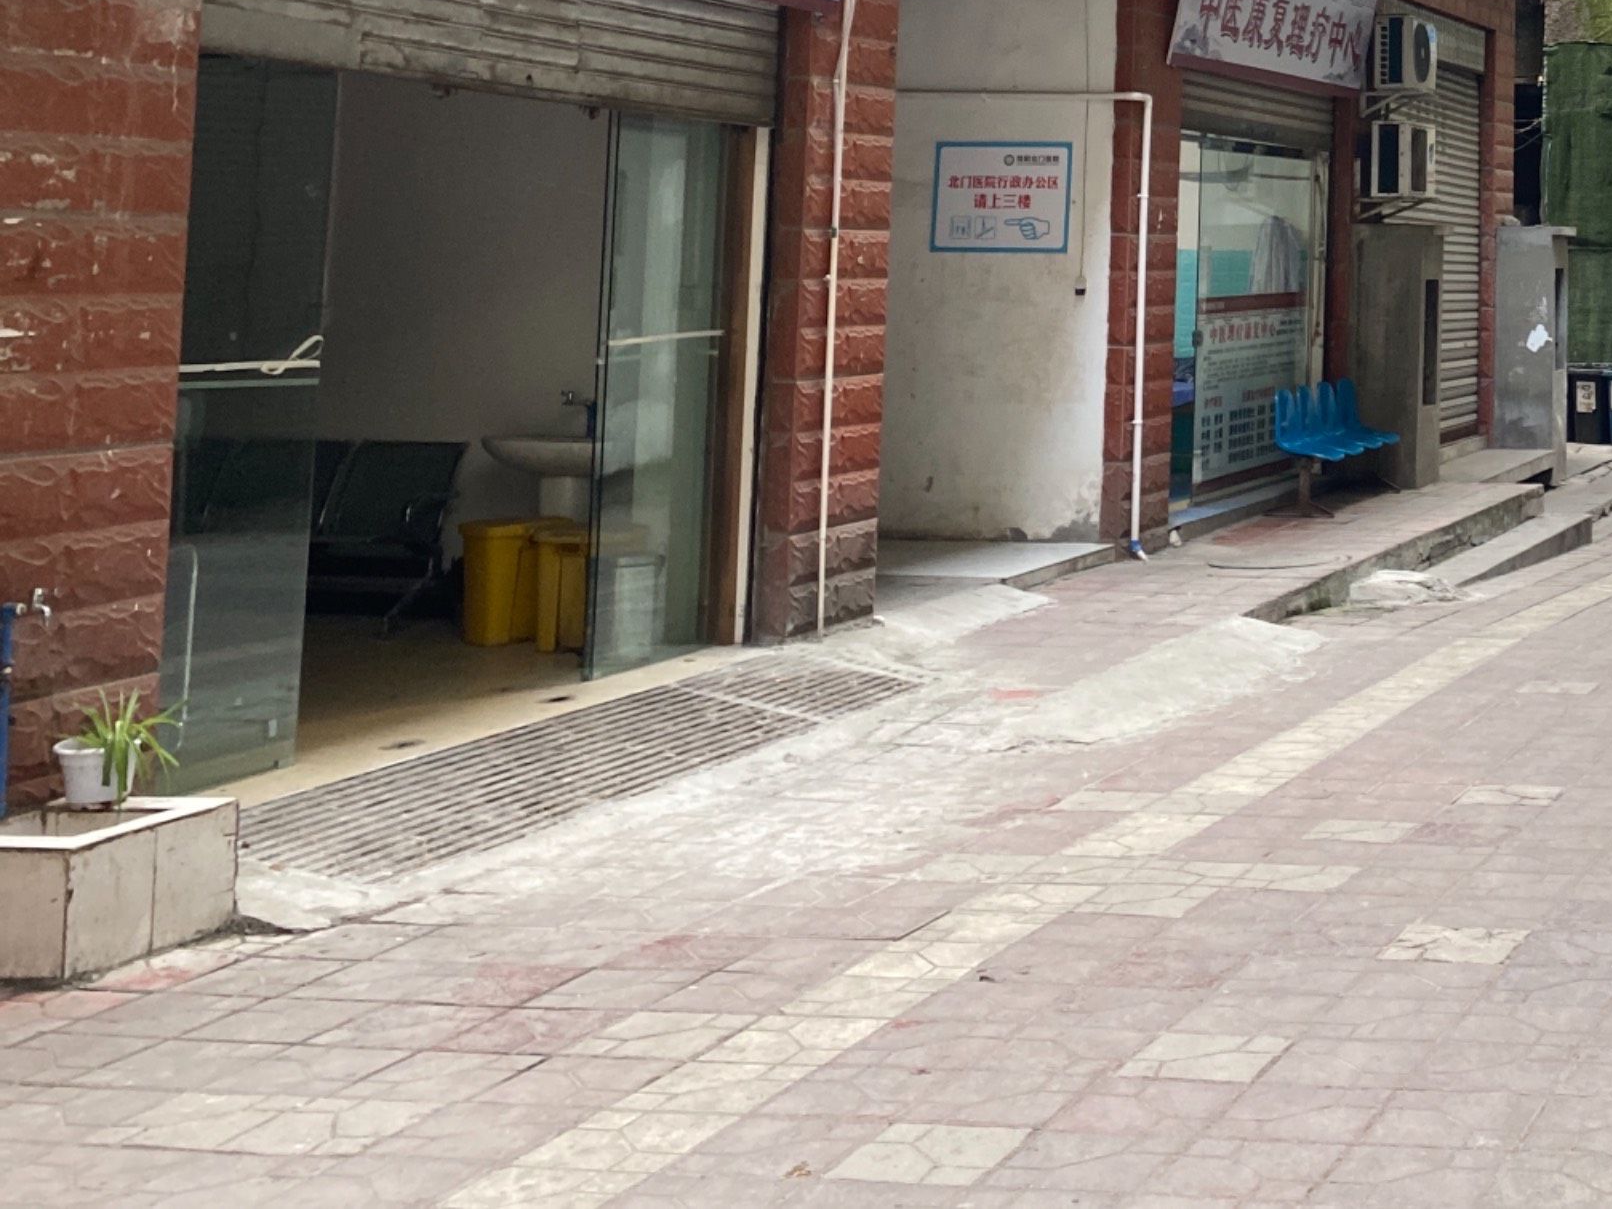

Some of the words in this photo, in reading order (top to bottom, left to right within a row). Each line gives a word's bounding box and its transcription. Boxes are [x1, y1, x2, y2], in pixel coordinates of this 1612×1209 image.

[948, 174, 1059, 190] 北门医院行政办公区
[974, 193, 1032, 210] 请上三楼
